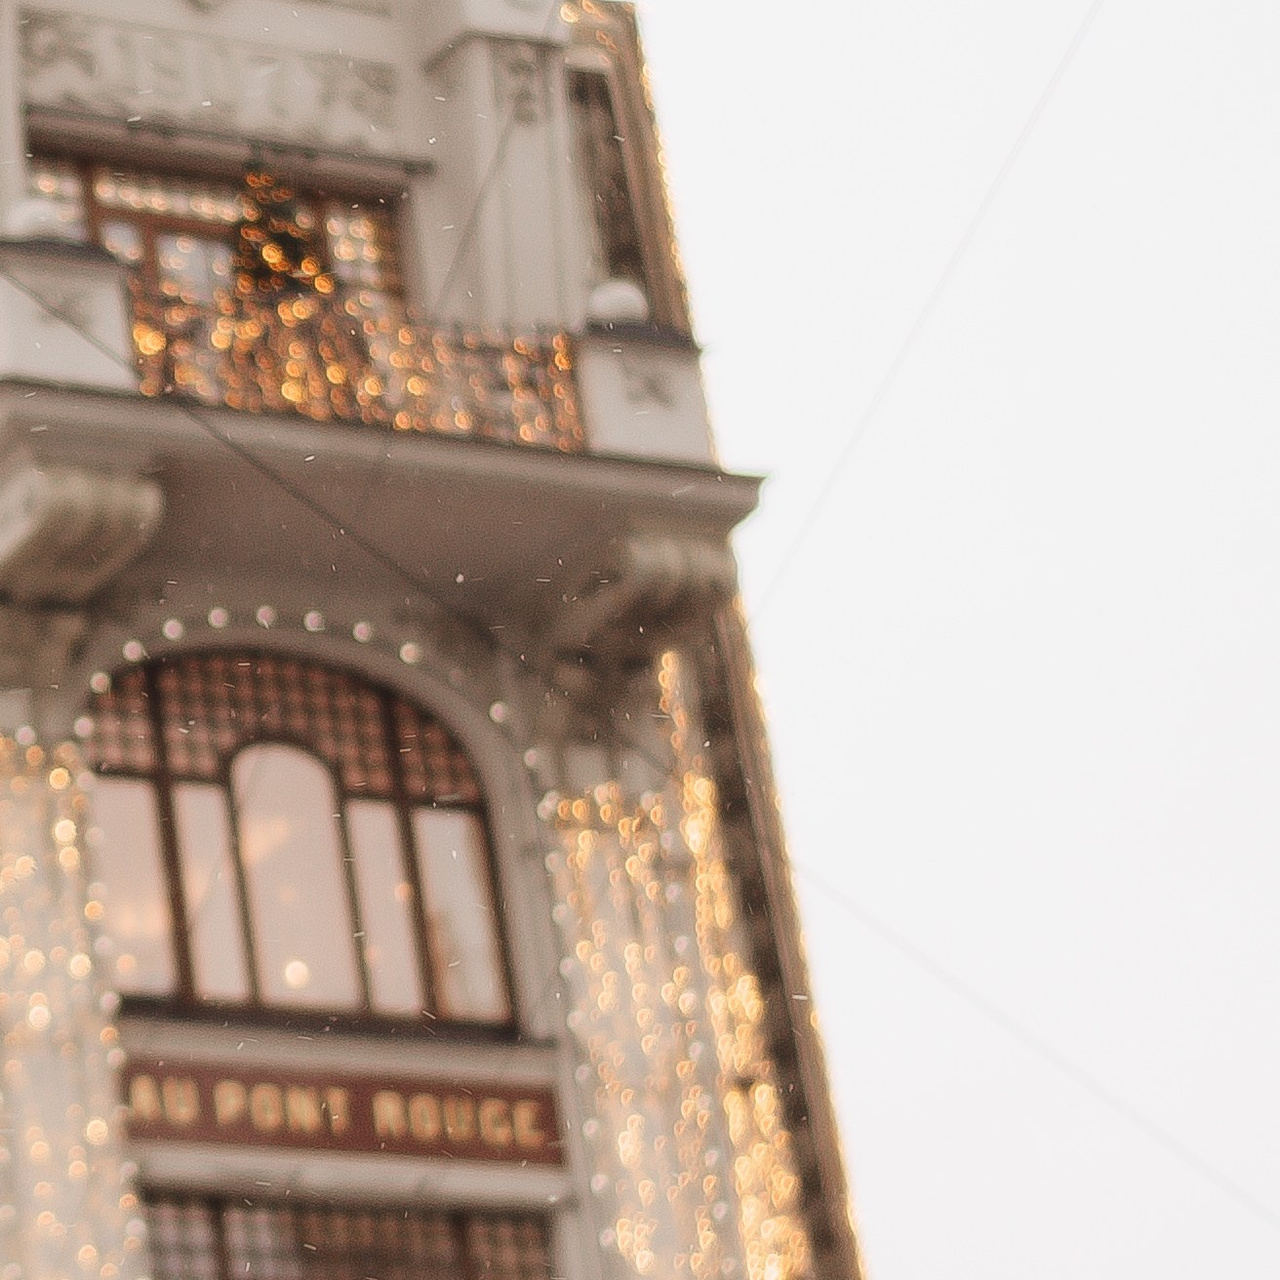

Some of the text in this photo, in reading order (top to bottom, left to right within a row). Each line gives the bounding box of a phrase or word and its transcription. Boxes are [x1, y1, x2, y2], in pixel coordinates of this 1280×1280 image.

[129, 1074, 546, 1148] AU PONT ROUGE
